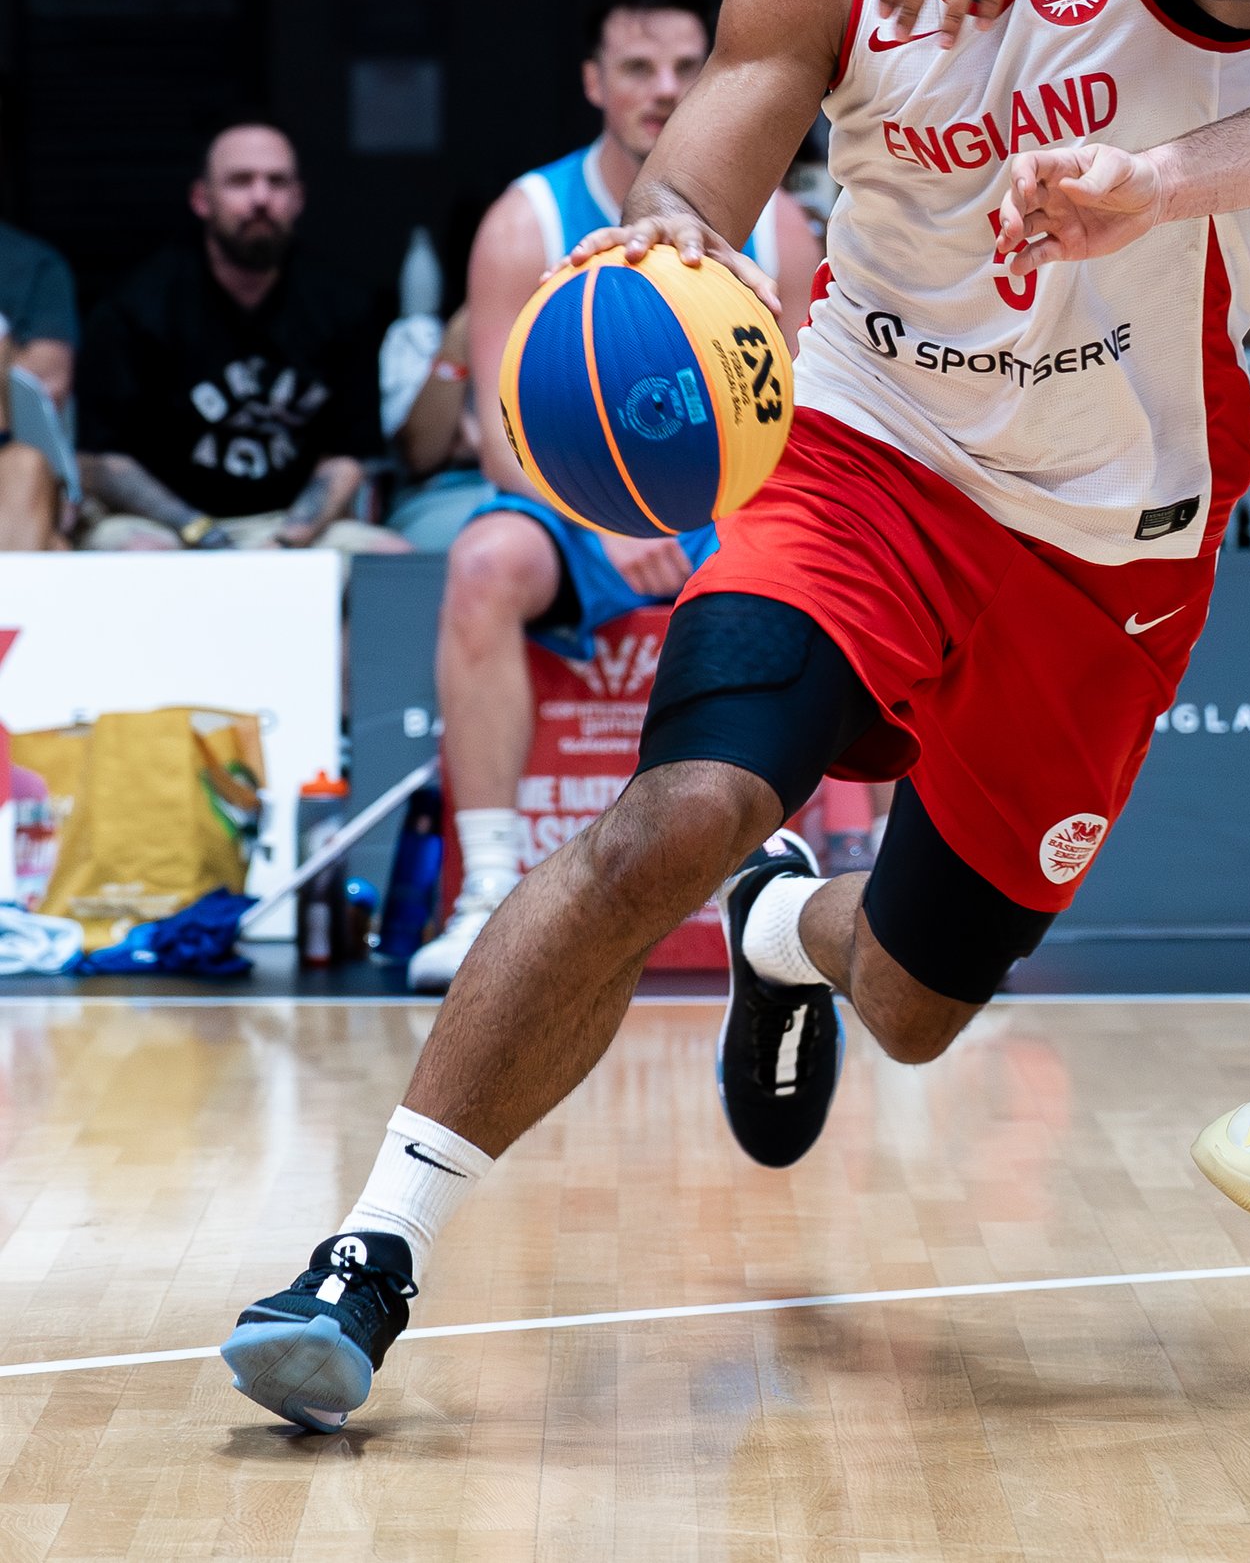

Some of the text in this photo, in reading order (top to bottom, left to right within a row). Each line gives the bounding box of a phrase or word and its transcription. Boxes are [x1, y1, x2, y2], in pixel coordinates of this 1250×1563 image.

[882, 71, 1118, 173] ENGLAND
[915, 322, 1131, 389] SPORTSERVE
[1180, 509, 1187, 521] L
